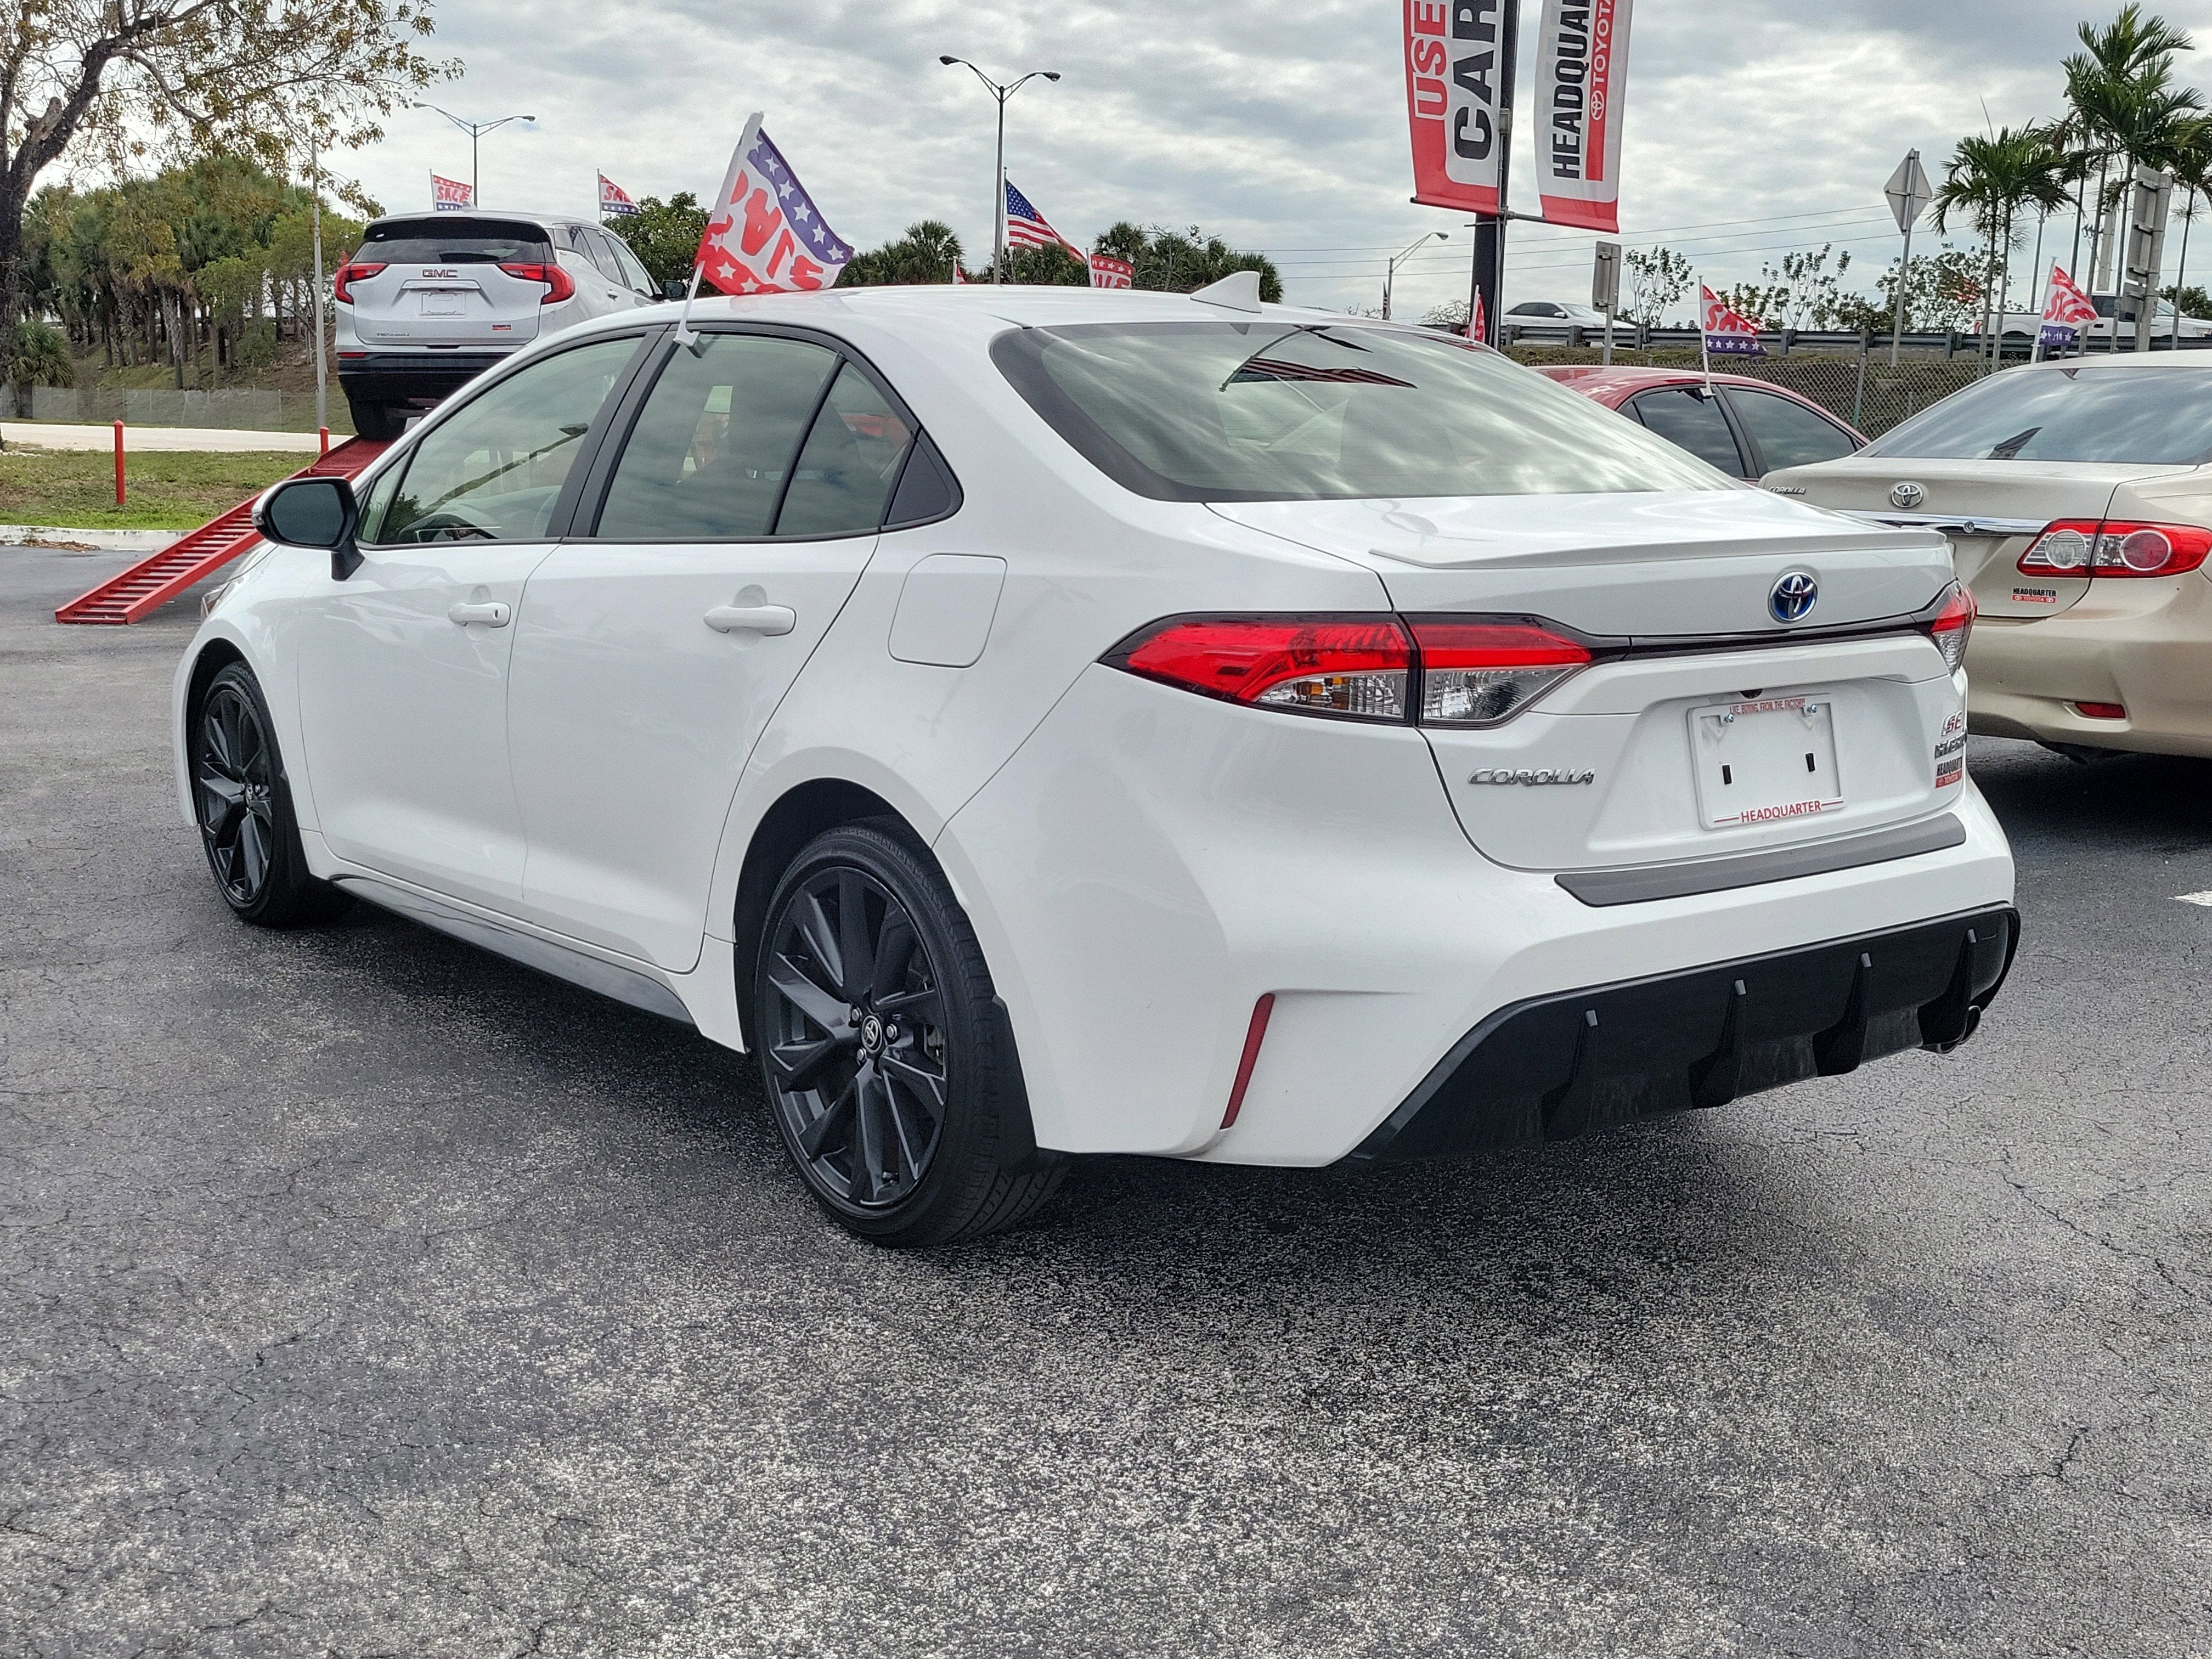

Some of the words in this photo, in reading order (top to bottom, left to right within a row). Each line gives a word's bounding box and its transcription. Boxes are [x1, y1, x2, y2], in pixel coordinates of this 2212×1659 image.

[422, 269, 458, 278] GMC
[2013, 588, 2056, 597] HEADQUARTER
[1760, 702, 1773, 712] FROM
[1775, 701, 1784, 710] THE
[1942, 710, 1962, 736] SE
[1468, 768, 1595, 786] COROLLA
[1741, 800, 1821, 822] HEADQUARTER
